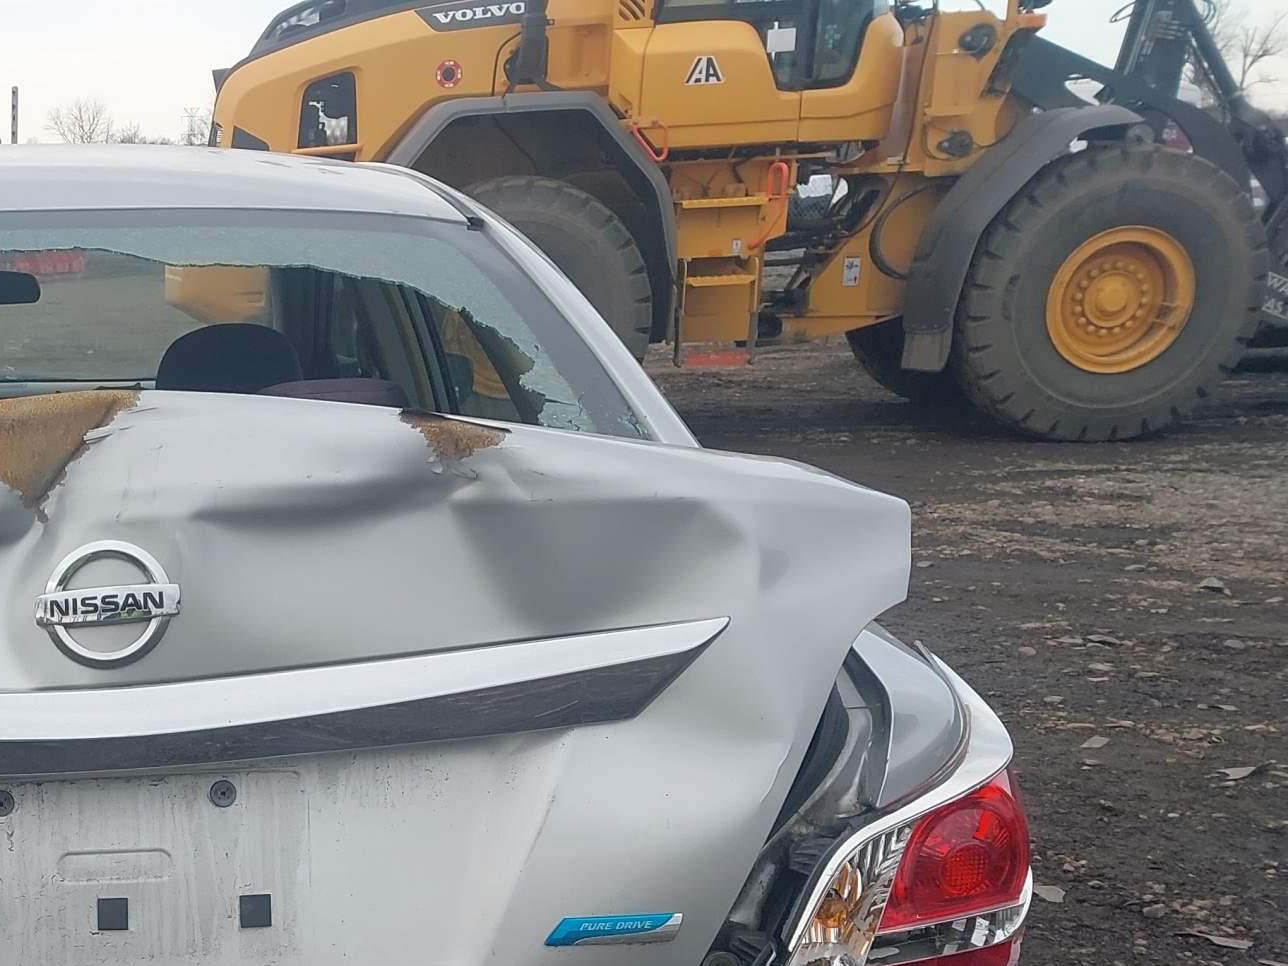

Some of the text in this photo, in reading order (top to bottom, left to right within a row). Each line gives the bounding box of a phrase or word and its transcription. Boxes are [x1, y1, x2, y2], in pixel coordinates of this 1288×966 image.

[432, 2, 525, 24] VOLVO
[49, 591, 164, 618] NISSAN
[580, 920, 653, 931] PURE DRIVE
